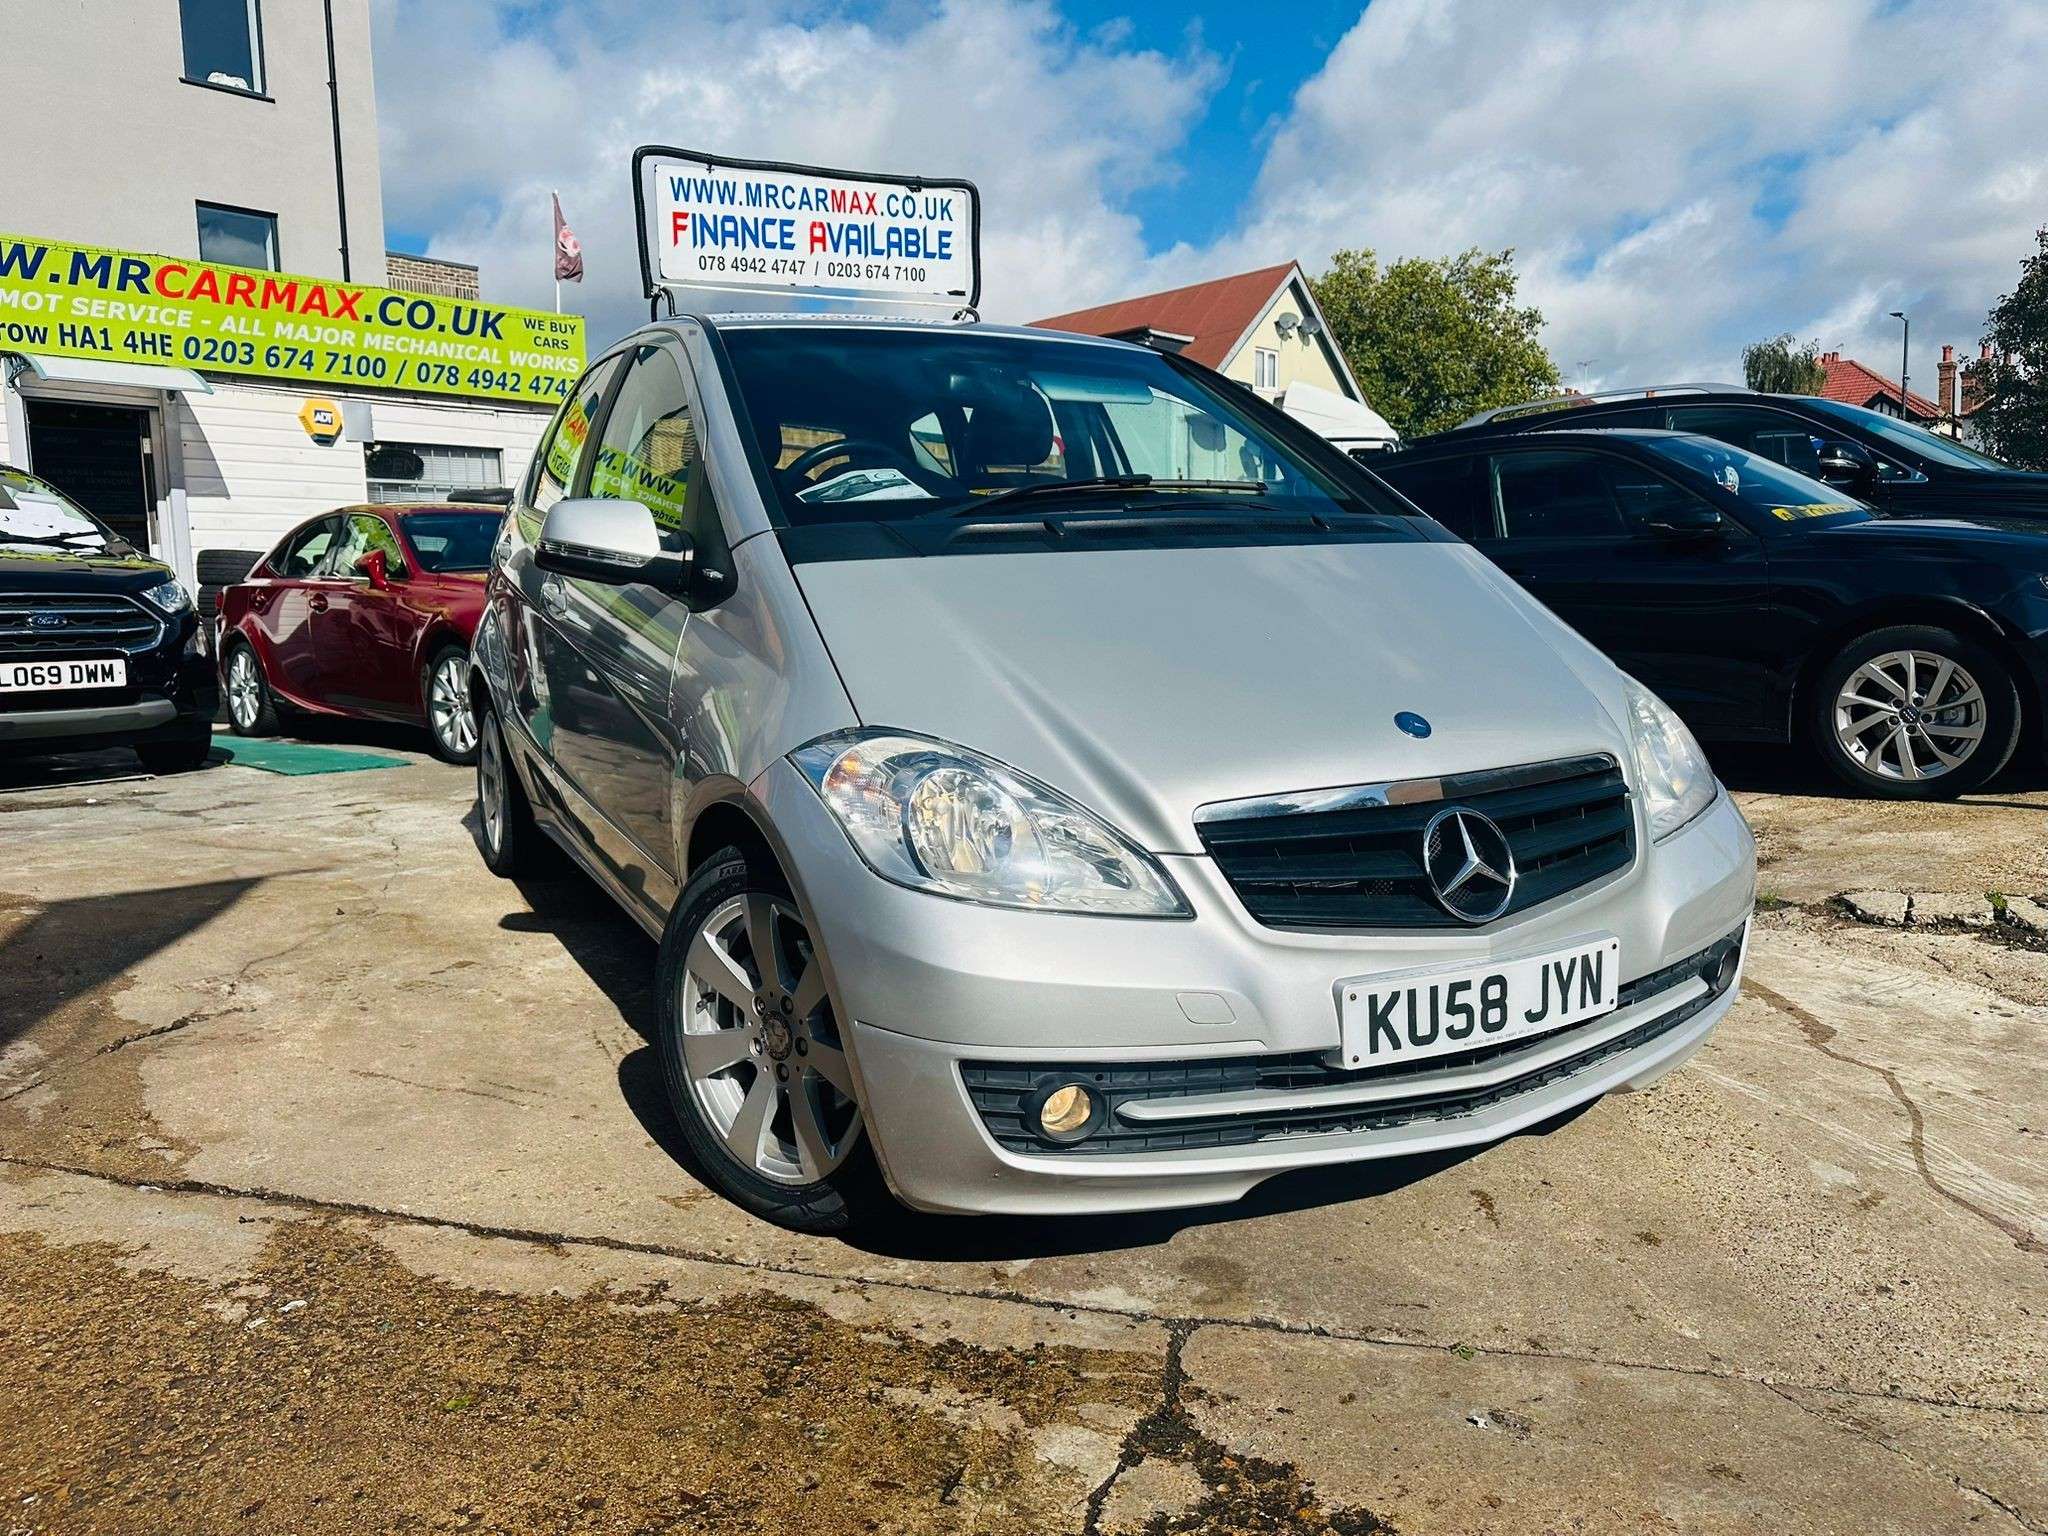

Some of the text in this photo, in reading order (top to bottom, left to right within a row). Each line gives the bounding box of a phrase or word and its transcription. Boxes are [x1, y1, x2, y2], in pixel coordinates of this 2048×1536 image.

[670, 176, 953, 222] WWW.MRCARMAX.CO.UK
[672, 211, 953, 261] FINANCE AVAILABLE
[699, 255, 926, 283] 078 4942 4747 / 0203 674 7100
[0, 288, 63, 312] MOT
[71, 297, 193, 328] SERVICE
[219, 315, 266, 337] ALL
[274, 321, 355, 348] MAJOR
[363, 332, 501, 365] MECHANICAL
[509, 351, 579, 373] WORKS
[523, 318, 577, 336] WE BUY
[533, 335, 570, 350] CARS
[58, 323, 113, 351] HA1
[123, 331, 173, 357] 4HE
[183, 336, 255, 365] 0203
[265, 345, 315, 371] 674
[325, 352, 386, 379] 7100
[395, 360, 408, 384] /
[417, 362, 459, 386] 078
[467, 368, 521, 393] 4942
[528, 375, 576, 397] 474
[314, 411, 333, 425] ADT
[69, 663, 115, 684] DWM
[1368, 950, 1603, 1055] KU58 JYN
